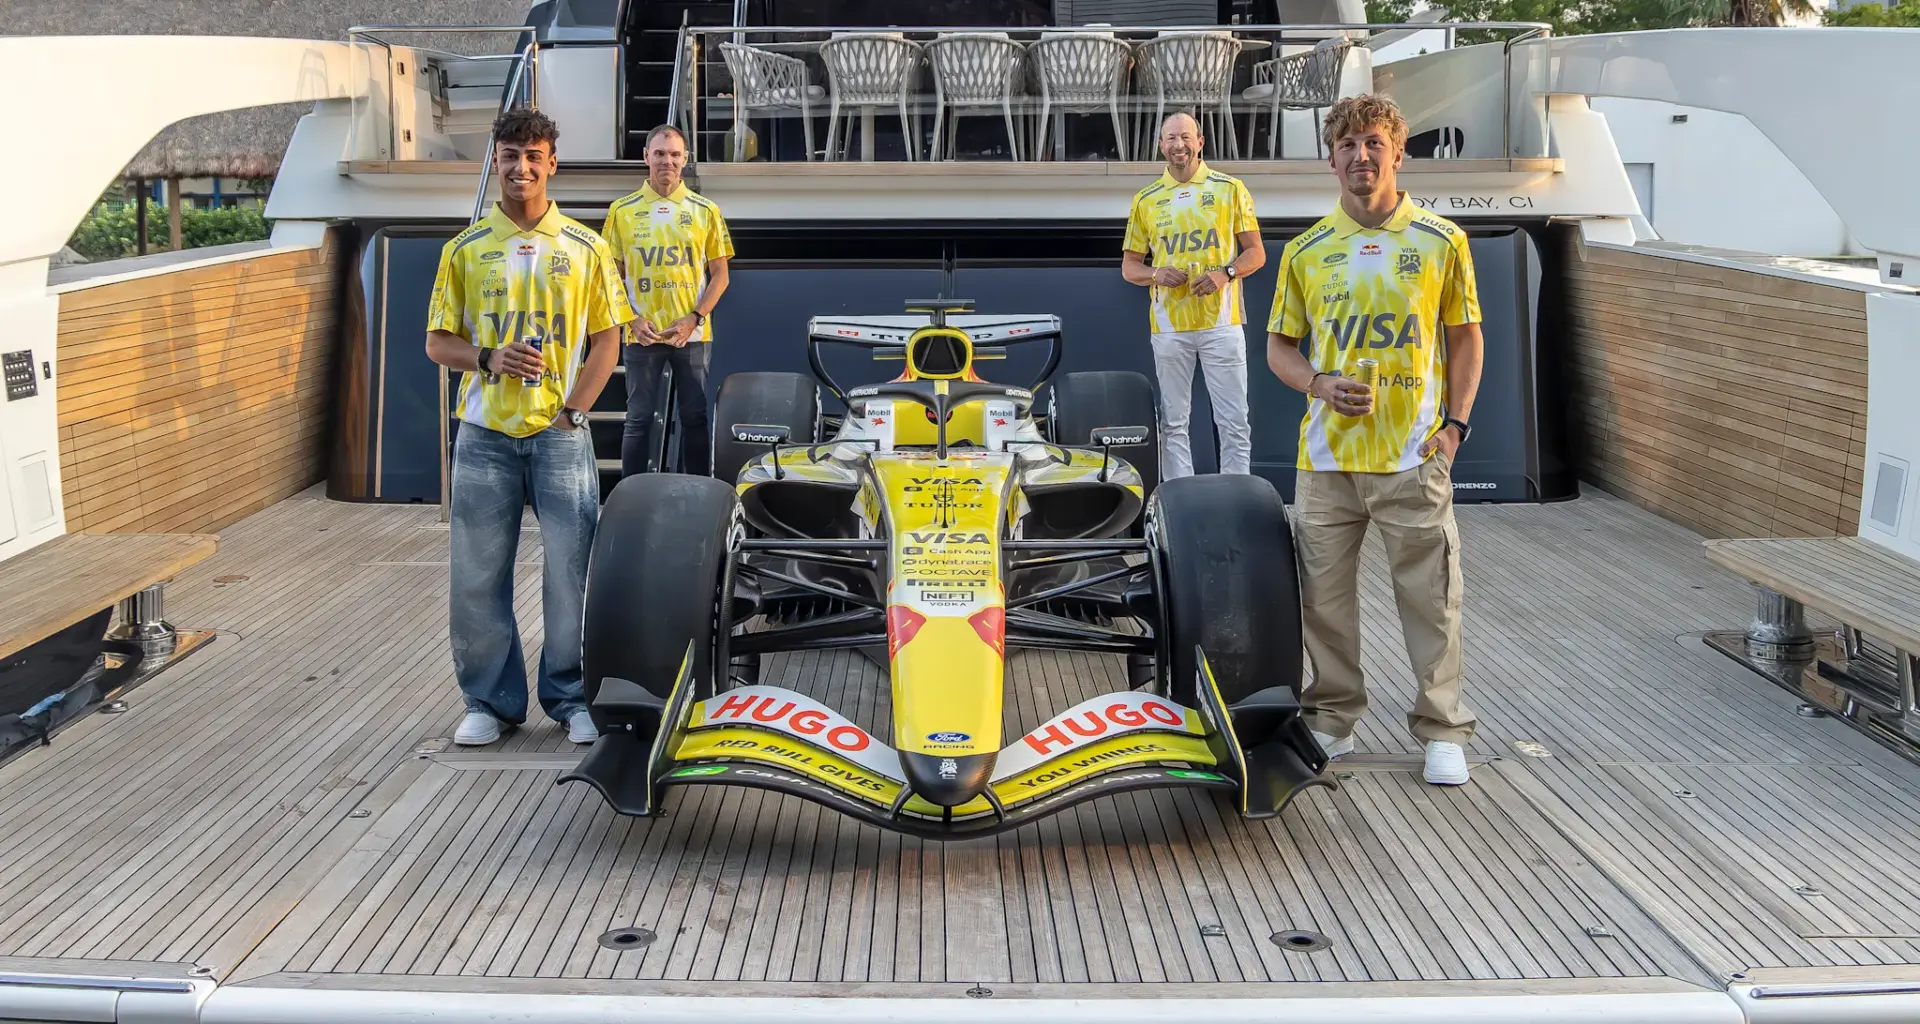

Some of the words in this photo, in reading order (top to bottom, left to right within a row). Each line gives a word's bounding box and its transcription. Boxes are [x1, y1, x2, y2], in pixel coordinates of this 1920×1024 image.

[1449, 196, 1499, 210] BAY,
[1509, 196, 1534, 208] CI
[565, 225, 596, 243] HUGO
[1420, 216, 1455, 236] HUGO
[453, 225, 483, 245] HUGO
[1160, 228, 1220, 255] VISA
[1295, 224, 1327, 247] HUGO
[635, 246, 694, 267] VISA
[654, 279, 677, 289] Cash
[1322, 281, 1348, 291] TUDOR
[482, 287, 508, 299] Mobil
[1323, 291, 1350, 304] Mobil
[484, 310, 567, 348] VISA
[1324, 313, 1422, 350] VISA
[1392, 373, 1423, 390] App
[748, 433, 780, 442] hahnair
[1112, 435, 1143, 444] hahnair
[909, 477, 983, 485] VISA
[909, 532, 991, 545] VISA
[918, 558, 992, 566] dynatrace
[918, 568, 992, 576] OCTAVE
[906, 578, 987, 587] PIRELLI
[710, 695, 870, 752] HUGO
[1022, 701, 1184, 756] HUGO
[714, 738, 758, 750] RED
[759, 743, 813, 765] BULL
[818, 763, 886, 793] GIVES
[1018, 766, 1071, 788] YOU
